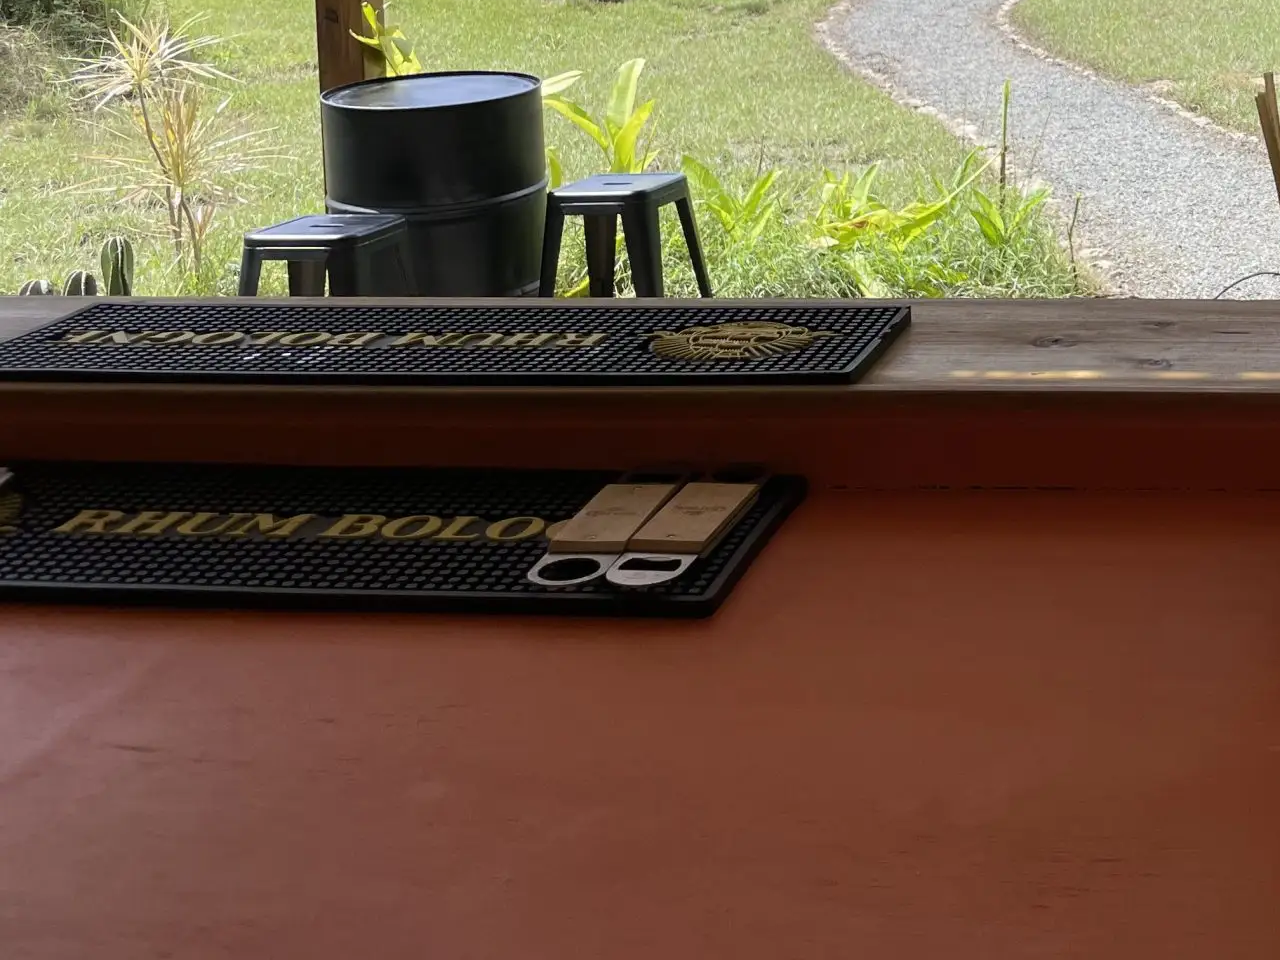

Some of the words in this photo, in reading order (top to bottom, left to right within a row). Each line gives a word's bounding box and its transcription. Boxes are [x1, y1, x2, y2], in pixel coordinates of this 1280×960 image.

[58, 329, 387, 347] BOLOGNE
[390, 331, 609, 347] RHUM
[53, 509, 317, 537] RHUM
[316, 513, 573, 540] BOLO
